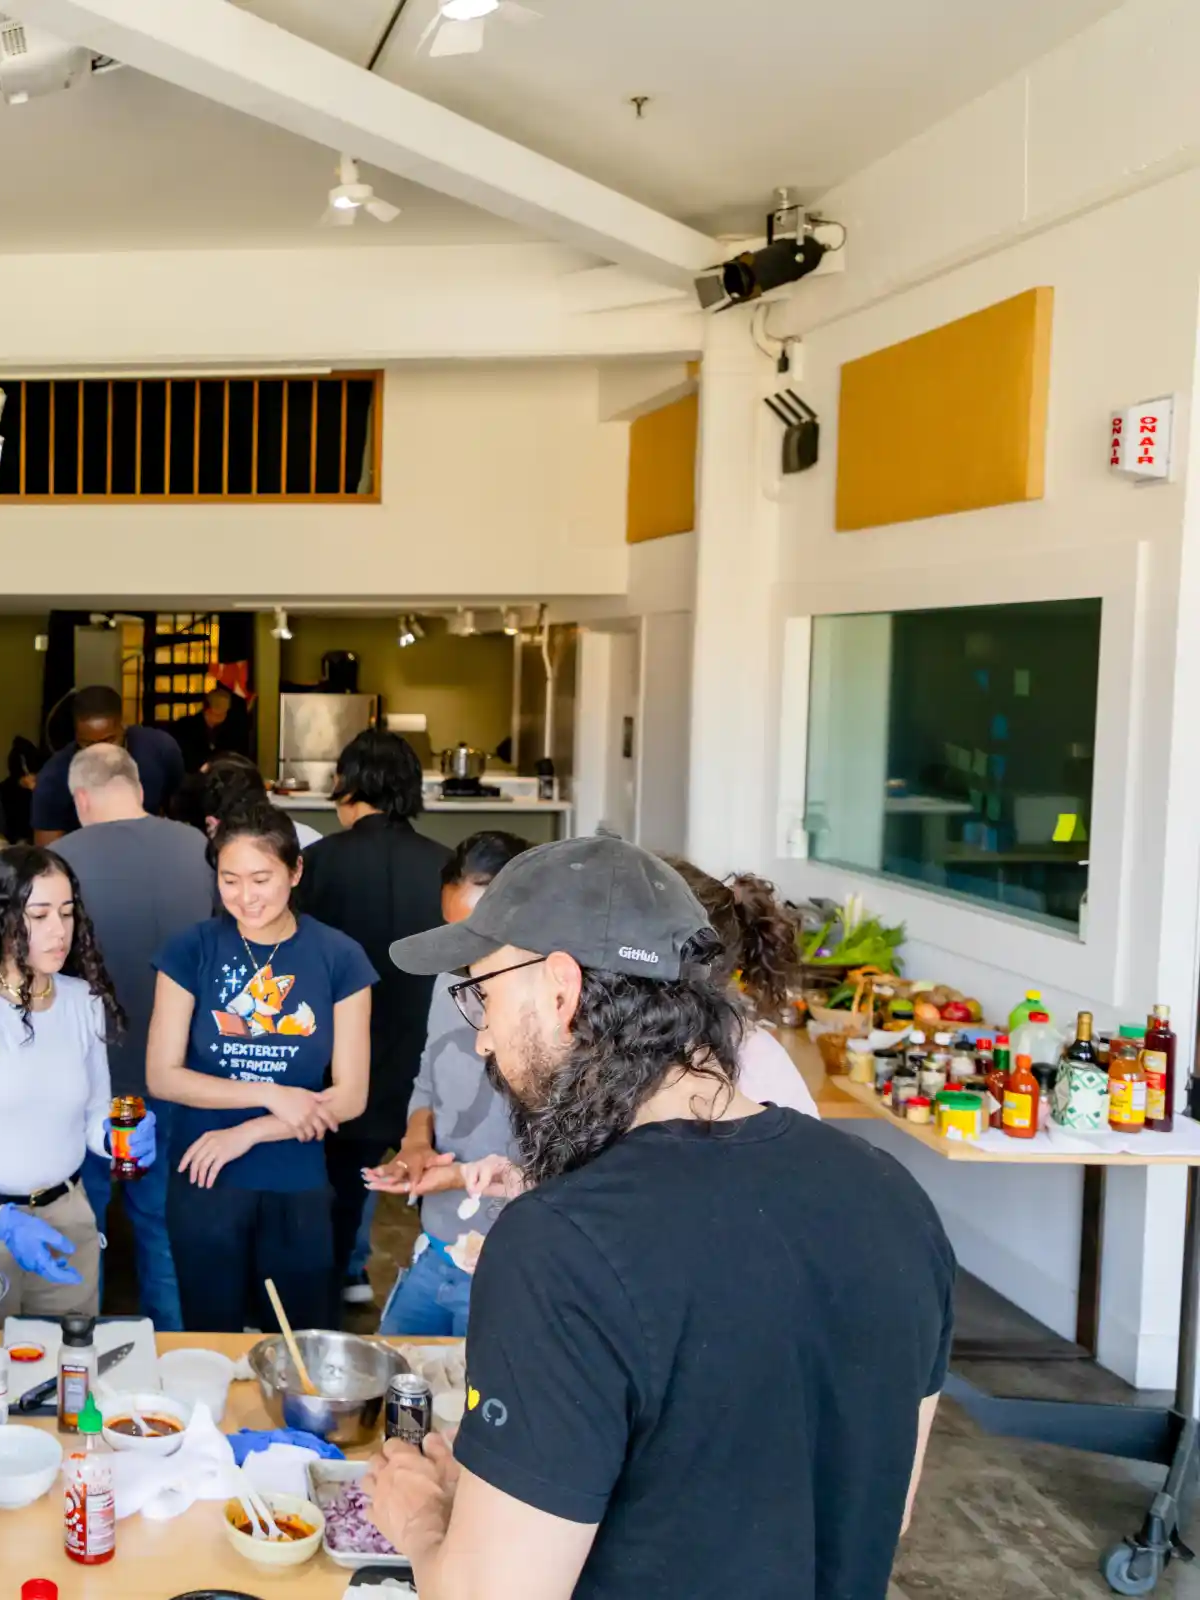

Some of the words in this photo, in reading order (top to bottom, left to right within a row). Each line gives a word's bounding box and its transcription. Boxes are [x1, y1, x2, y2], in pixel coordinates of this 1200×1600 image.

[1112, 417, 1122, 435] ON
[1139, 416, 1158, 433] ON
[1138, 436, 1155, 464] AIR
[619, 946, 659, 963] GitHub
[223, 1042, 299, 1058] DEXTERITY
[230, 1058, 288, 1073] STAMINA
